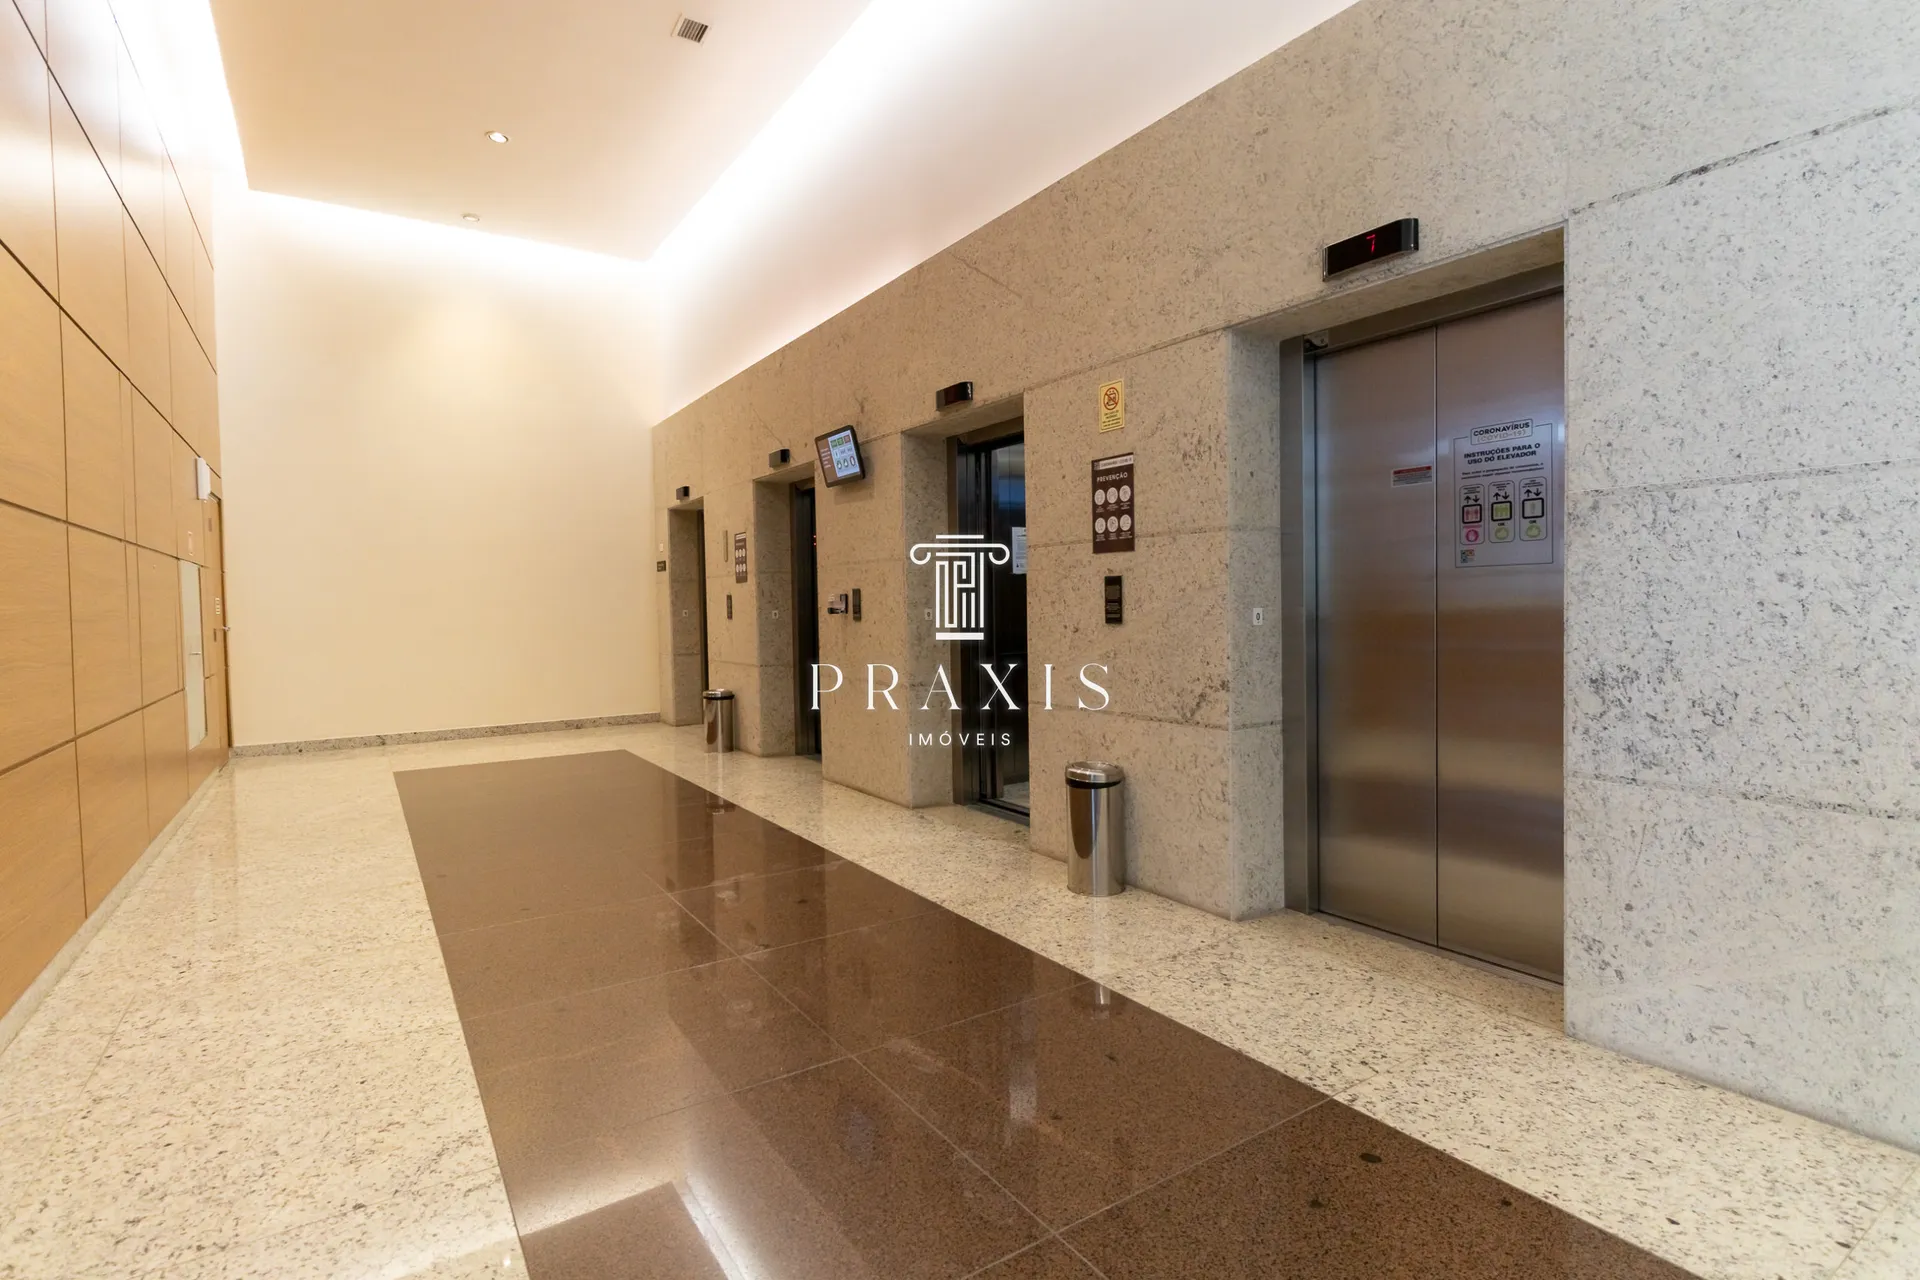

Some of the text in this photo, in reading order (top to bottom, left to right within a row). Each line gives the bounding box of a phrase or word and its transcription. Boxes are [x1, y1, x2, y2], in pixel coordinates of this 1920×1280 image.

[1366, 234, 1376, 253] 7
[1473, 422, 1530, 437] CORONAVÍRUS
[1476, 429, 1526, 443] (COVID-19)
[1464, 447, 1510, 459] INSTRUÇÕES
[1512, 444, 1532, 452] PARA
[1497, 450, 1537, 461] ELEVADOR
[1096, 472, 1128, 483] PREVENÇÃO
